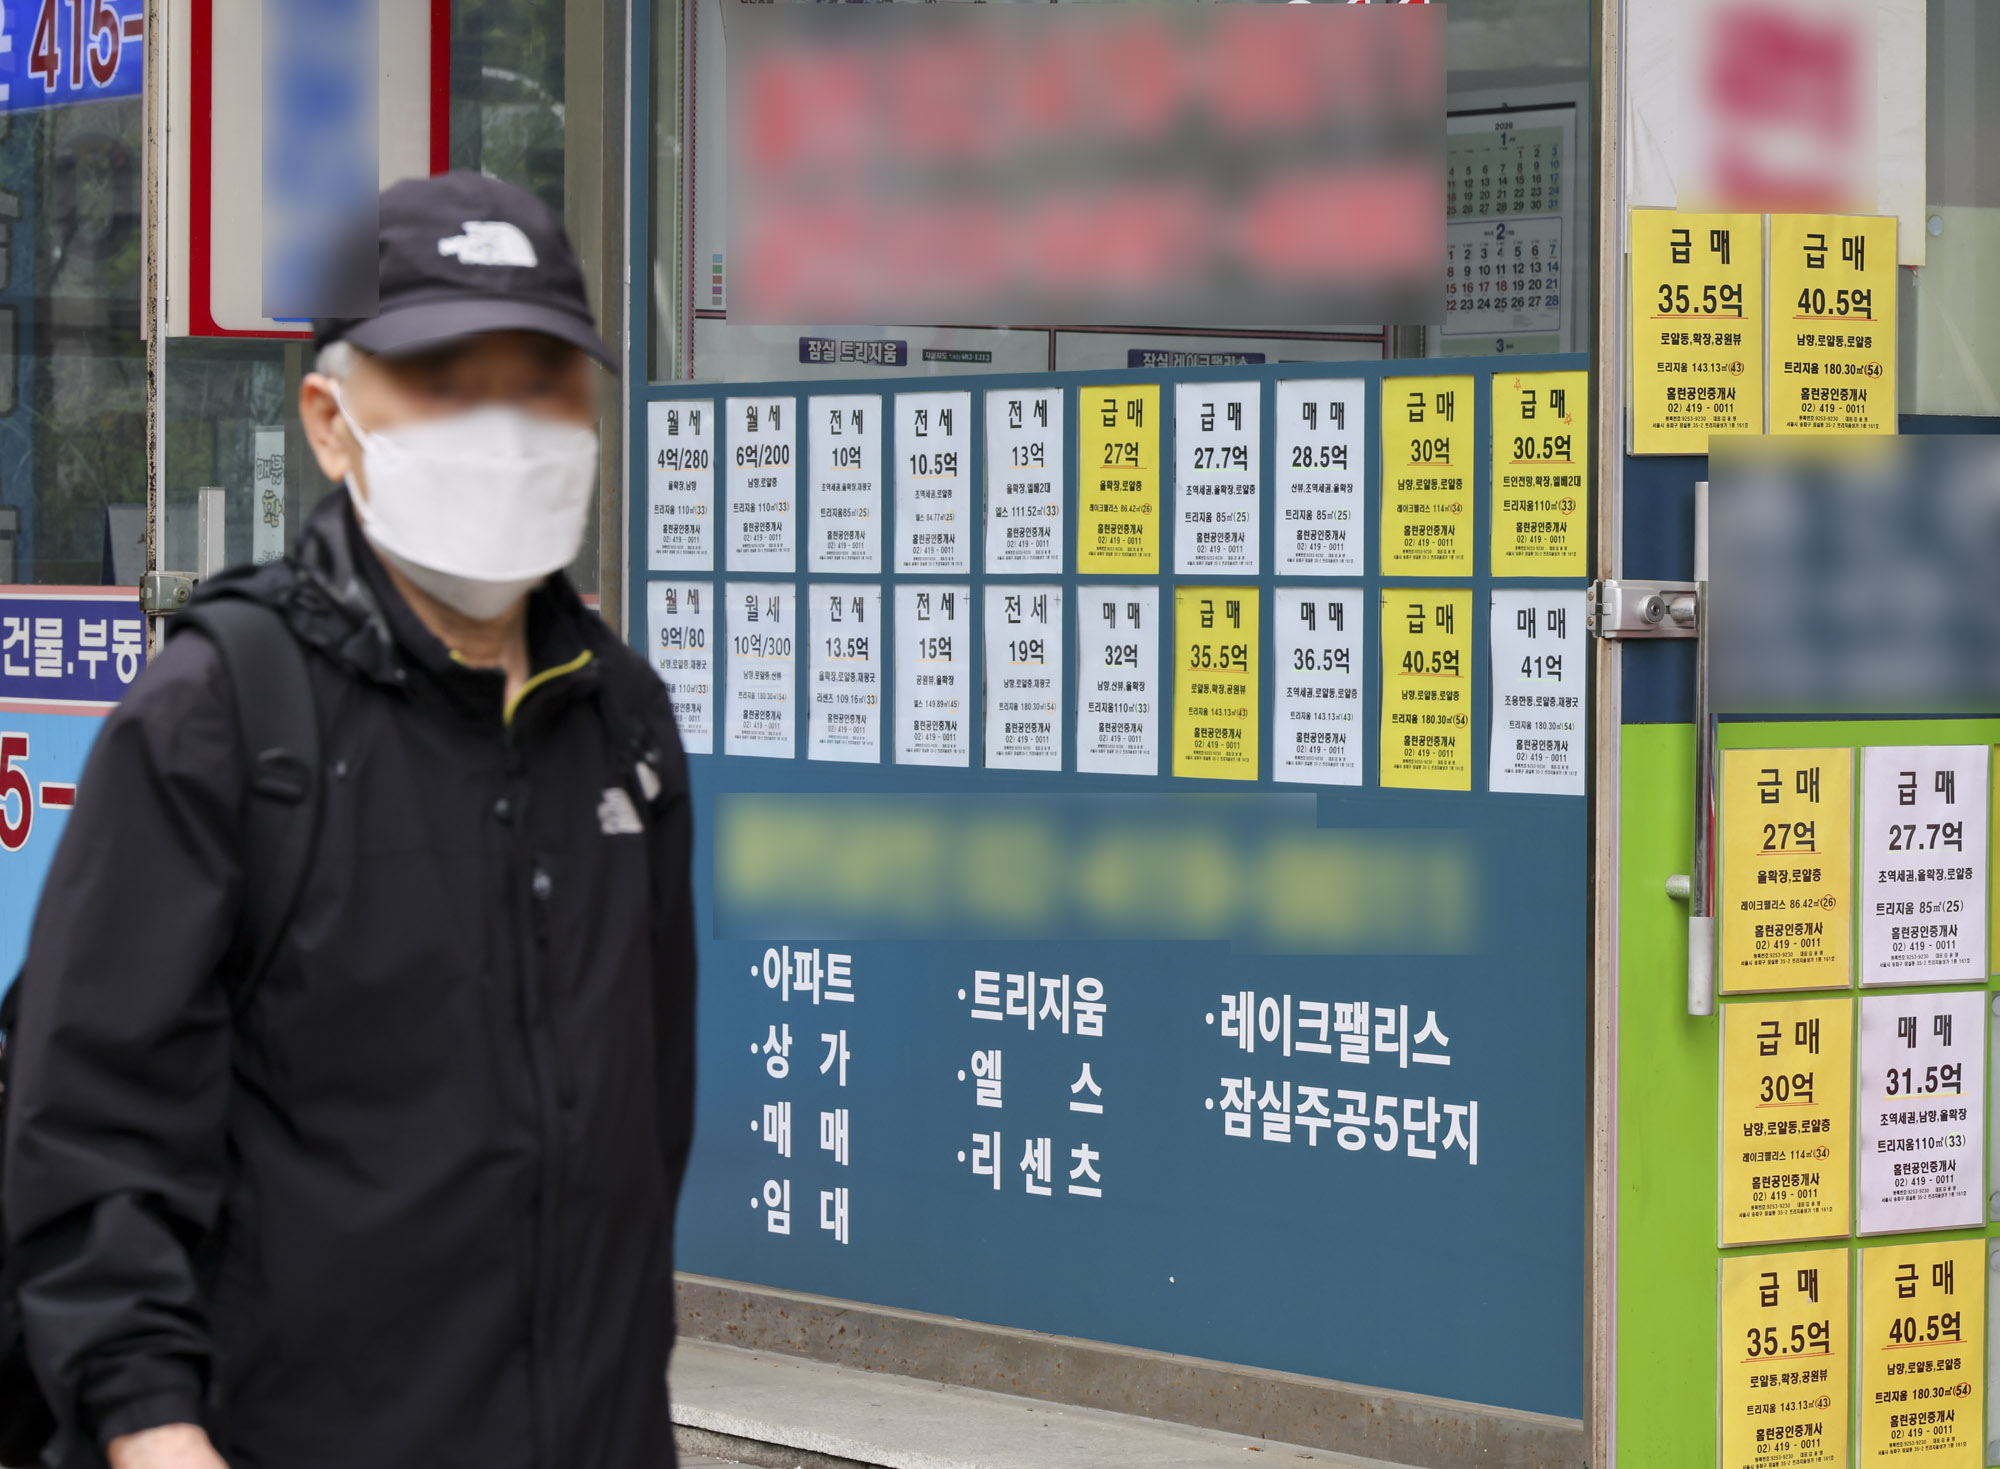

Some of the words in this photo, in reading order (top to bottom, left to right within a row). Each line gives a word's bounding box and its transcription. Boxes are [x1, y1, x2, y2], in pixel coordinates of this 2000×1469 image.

[1495, 122, 1513, 130] 2026
[1501, 132, 1506, 145] 1
[1496, 224, 1506, 240] 2
[1671, 229, 1691, 264] 급
[1710, 230, 1730, 264] 매
[1804, 234, 1828, 268] 급
[1843, 236, 1864, 271] 매
[1464, 266, 1471, 276] 9
[1479, 265, 1490, 275] 10
[1496, 264, 1506, 274] 11
[1513, 264, 1524, 274] 12
[1530, 263, 1541, 272] 13
[1547, 262, 1558, 272] 14
[1659, 284, 1742, 317] 35.5억
[1798, 288, 1871, 319] 40.5억
[1496, 339, 1504, 352] 3
[1661, 333, 1741, 345] 로얄동,확장,공원뷰
[1797, 334, 1872, 348] 남향,로얄동,로얄층
[808, 341, 835, 361] 잠실
[841, 341, 897, 363] 트리지움
[1657, 362, 1688, 372] 트리지움
[1693, 363, 1744, 372] 143.13㎡(43)
[1784, 362, 1819, 374] 트리지움
[1825, 364, 1882, 376] 180.30㎡(54)
[658, 448, 708, 470] 4억/280
[737, 444, 789, 468] 6억/200
[832, 446, 860, 468] 10억
[1013, 442, 1043, 467] 13억
[1105, 442, 1138, 467] 27억
[1195, 445, 1247, 471] 27.7억
[1292, 445, 1347, 470] 28.5억
[1411, 438, 1449, 464] 30억
[1514, 435, 1570, 461] 30.5억
[910, 452, 957, 477] 10.5억
[661, 627, 704, 649] 9억/80
[735, 634, 790, 657] 10억/300
[826, 637, 868, 660] 13.5억
[920, 637, 951, 661] 15억
[1010, 639, 1043, 664] 19억
[1105, 645, 1137, 668] 32억
[1191, 644, 1247, 671] 35.5억
[1294, 648, 1349, 674] 36.5억
[1403, 650, 1459, 676] 40.5억
[1522, 655, 1561, 681] 41억
[1757, 769, 1782, 803] 급
[1797, 767, 1819, 803] 매
[1898, 772, 1917, 805] 급
[1935, 771, 1954, 804] 매
[1763, 821, 1815, 852] 27억
[1889, 821, 1962, 851] 27.7억
[1757, 868, 1821, 884] 올확장,로얄층
[1879, 868, 1972, 883] 초역세권,올확장,로얄층
[1741, 900, 1785, 910] 레이크팰리스
[1790, 898, 1836, 908] 86.42㎡(26)
[1876, 902, 1914, 915] 트리지움
[1920, 900, 1963, 913] 85㎡(25)
[1892, 924, 1957, 939] 홈런공인중개사
[1893, 943, 1905, 951] 02)
[1910, 942, 1924, 950] 419
[1936, 940, 1955, 949] 0011
[763, 946, 854, 1004] 아파트
[971, 970, 1106, 1036] 트리지움
[1221, 991, 1450, 1068] 레이크팰리스
[1757, 1021, 1781, 1056] 급
[1795, 1018, 1819, 1054] 매
[1898, 1017, 1916, 1048] 매
[1934, 1015, 1952, 1046] 매
[1761, 1072, 1813, 1103] 30억
[1886, 1063, 1961, 1095] 31.5억
[1220, 1077, 1478, 1165] 잠실주공5단지
[1744, 1119, 1830, 1136] 남향,로얄동,로얄층
[1880, 1108, 1967, 1126] 초역세권,남향,올확장
[1743, 1151, 1785, 1162] 레이크팰리스
[1791, 1149, 1829, 1159] 114㎡(34)
[1760, 1272, 1779, 1307] 급
[1798, 1269, 1818, 1302] 매
[1895, 1264, 1919, 1298] 급
[1933, 1260, 1953, 1295] 매
[1747, 1320, 1829, 1356] 35.5억
[1890, 1312, 1960, 1343] 40.5억
[1751, 1369, 1827, 1388] 로얄동,확장,공원뷰
[1888, 1358, 1961, 1375] 남향,로얄동,로얄층
[1747, 1404, 1776, 1415] 트리지움
[1781, 1398, 1830, 1411] 143.13㎡(43)
[1875, 1390, 1907, 1403] 트리지움
[1913, 1385, 1971, 1399] 180.30㎡(54)
